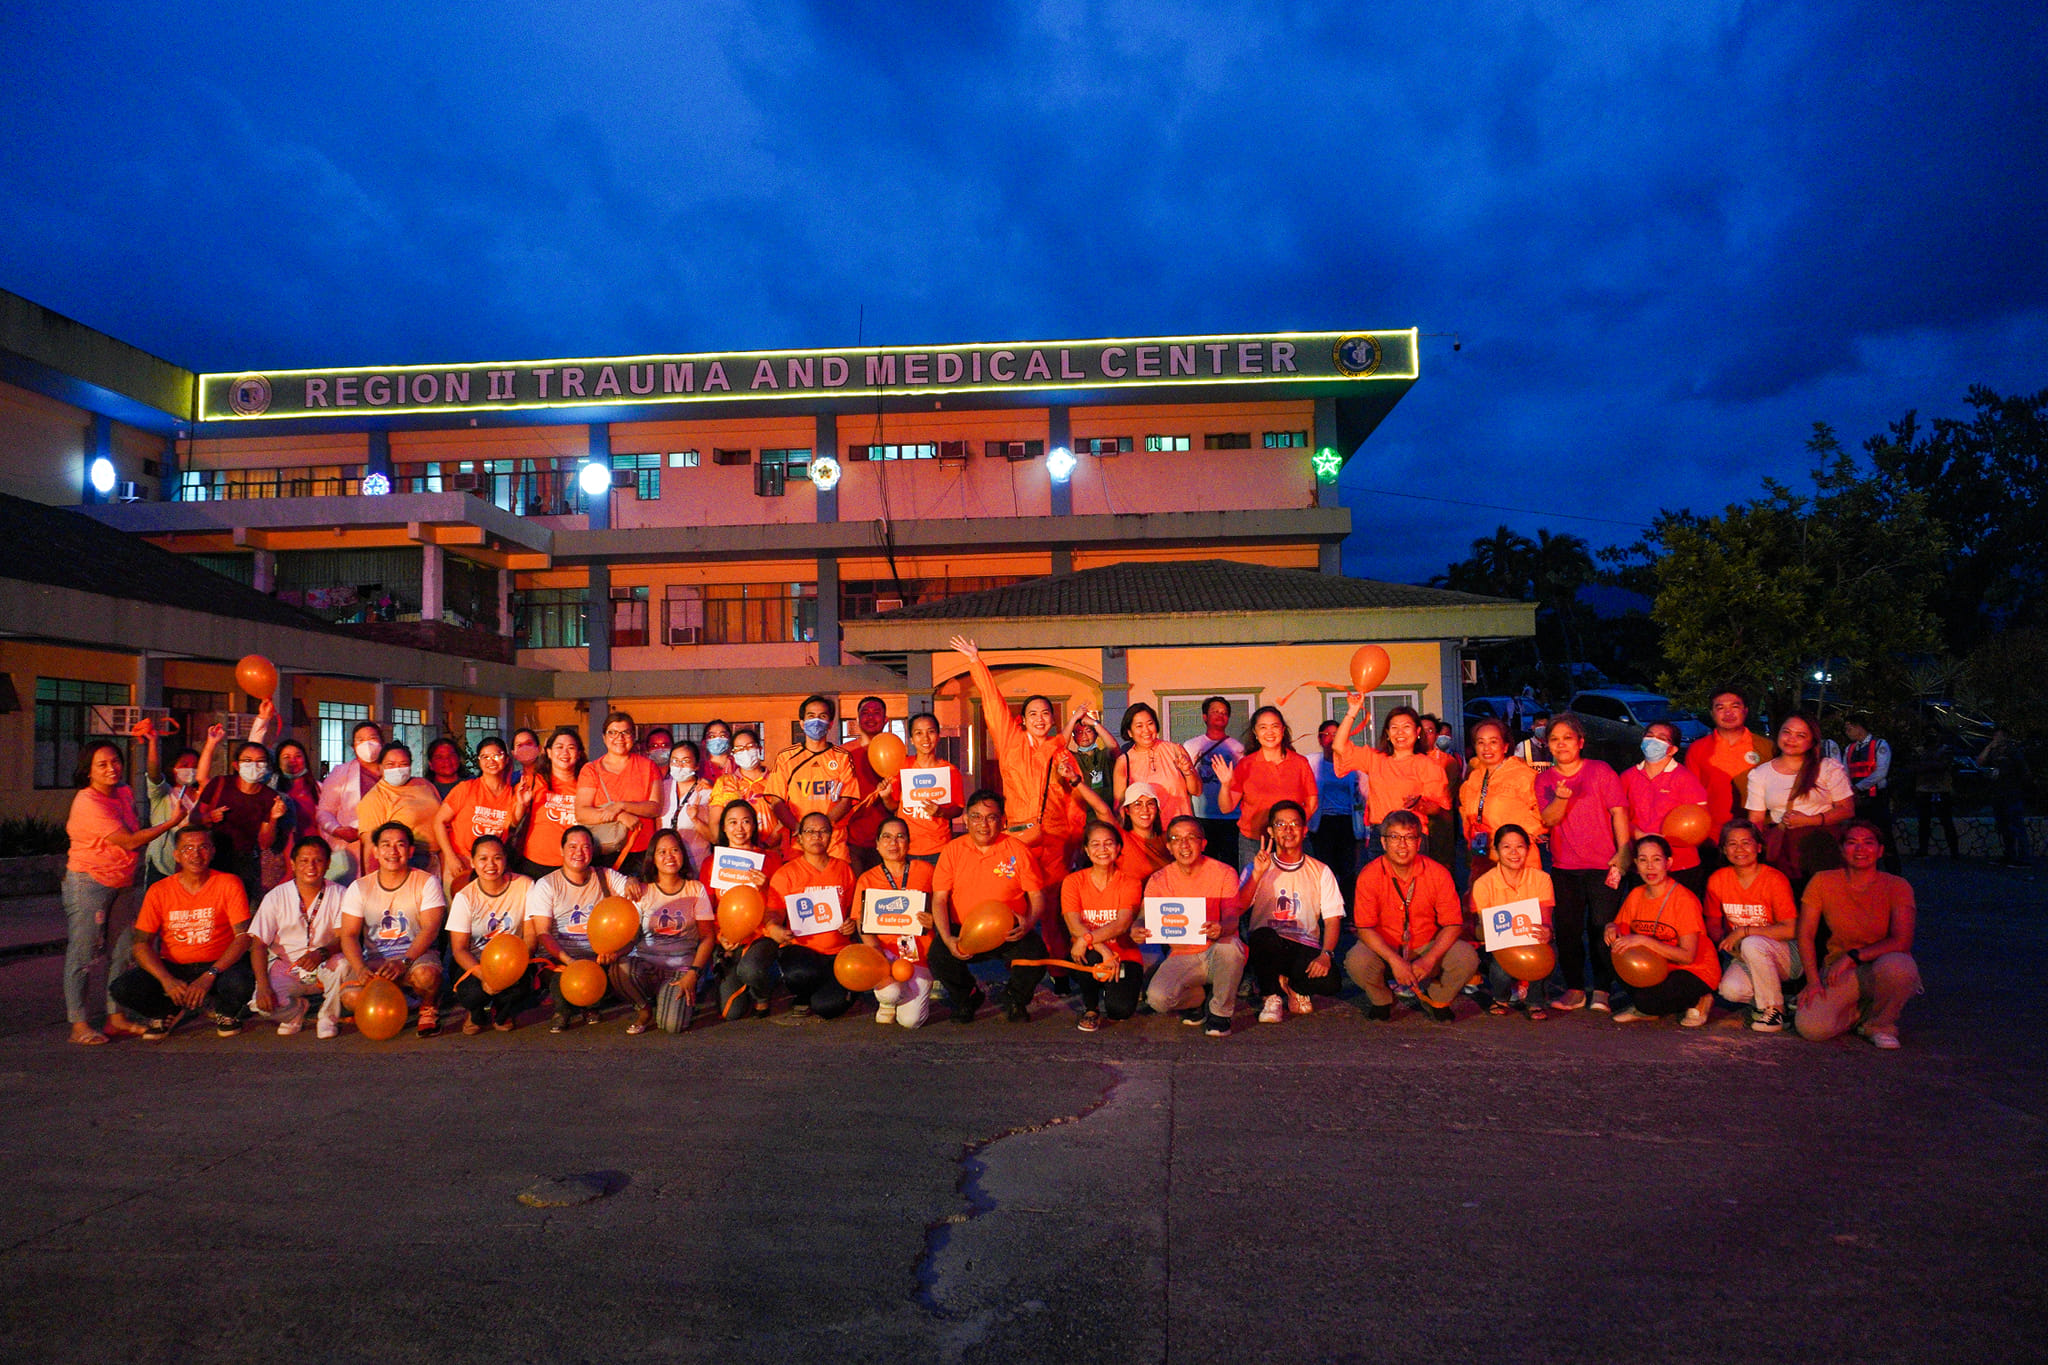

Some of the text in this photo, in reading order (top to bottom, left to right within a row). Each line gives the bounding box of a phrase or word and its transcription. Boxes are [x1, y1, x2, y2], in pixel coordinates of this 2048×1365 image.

[305, 372, 471, 408] REGION
[486, 370, 516, 400] II
[532, 361, 731, 399] TRAUMA
[750, 357, 850, 390] AND
[865, 349, 1086, 386] MEDICAL
[1100, 342, 1298, 378] CENTER
[800, 900, 808, 910] B
[818, 904, 825, 914] B
[1498, 913, 1506, 924] B
[1516, 916, 1525, 926] B
